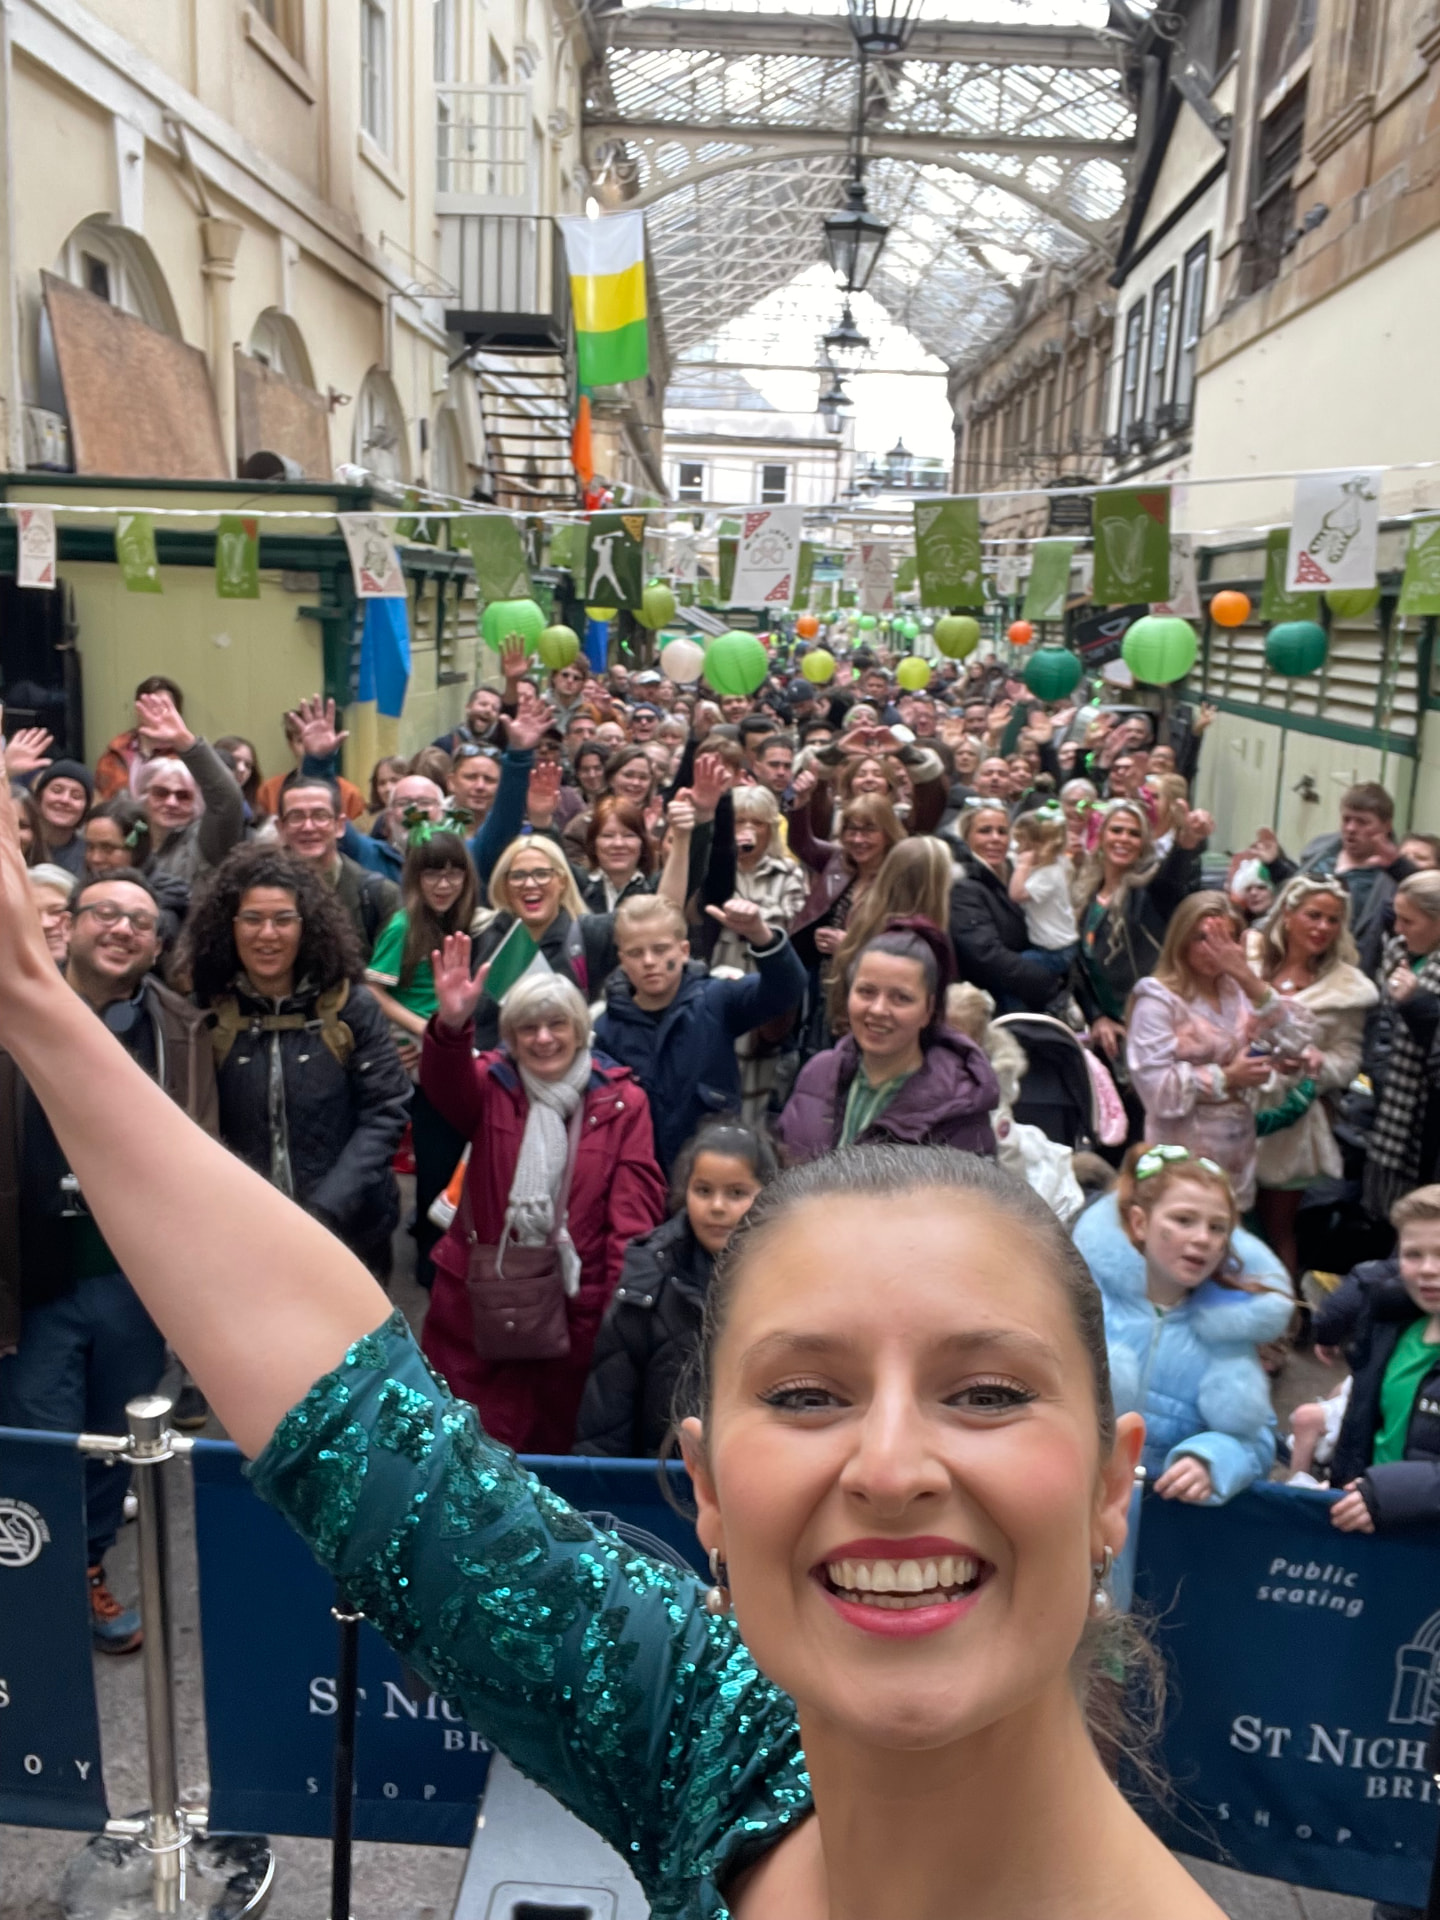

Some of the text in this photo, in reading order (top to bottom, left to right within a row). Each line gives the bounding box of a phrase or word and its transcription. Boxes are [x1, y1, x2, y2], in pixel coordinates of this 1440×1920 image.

[1419, 1398, 1440, 1415] BA
[1269, 1557, 1358, 1588] Public
[1257, 1585, 1364, 1618] seating
[309, 1677, 367, 1717] S
[306, 1777, 437, 1801] SOP
[1366, 1776, 1440, 1804] BRI
